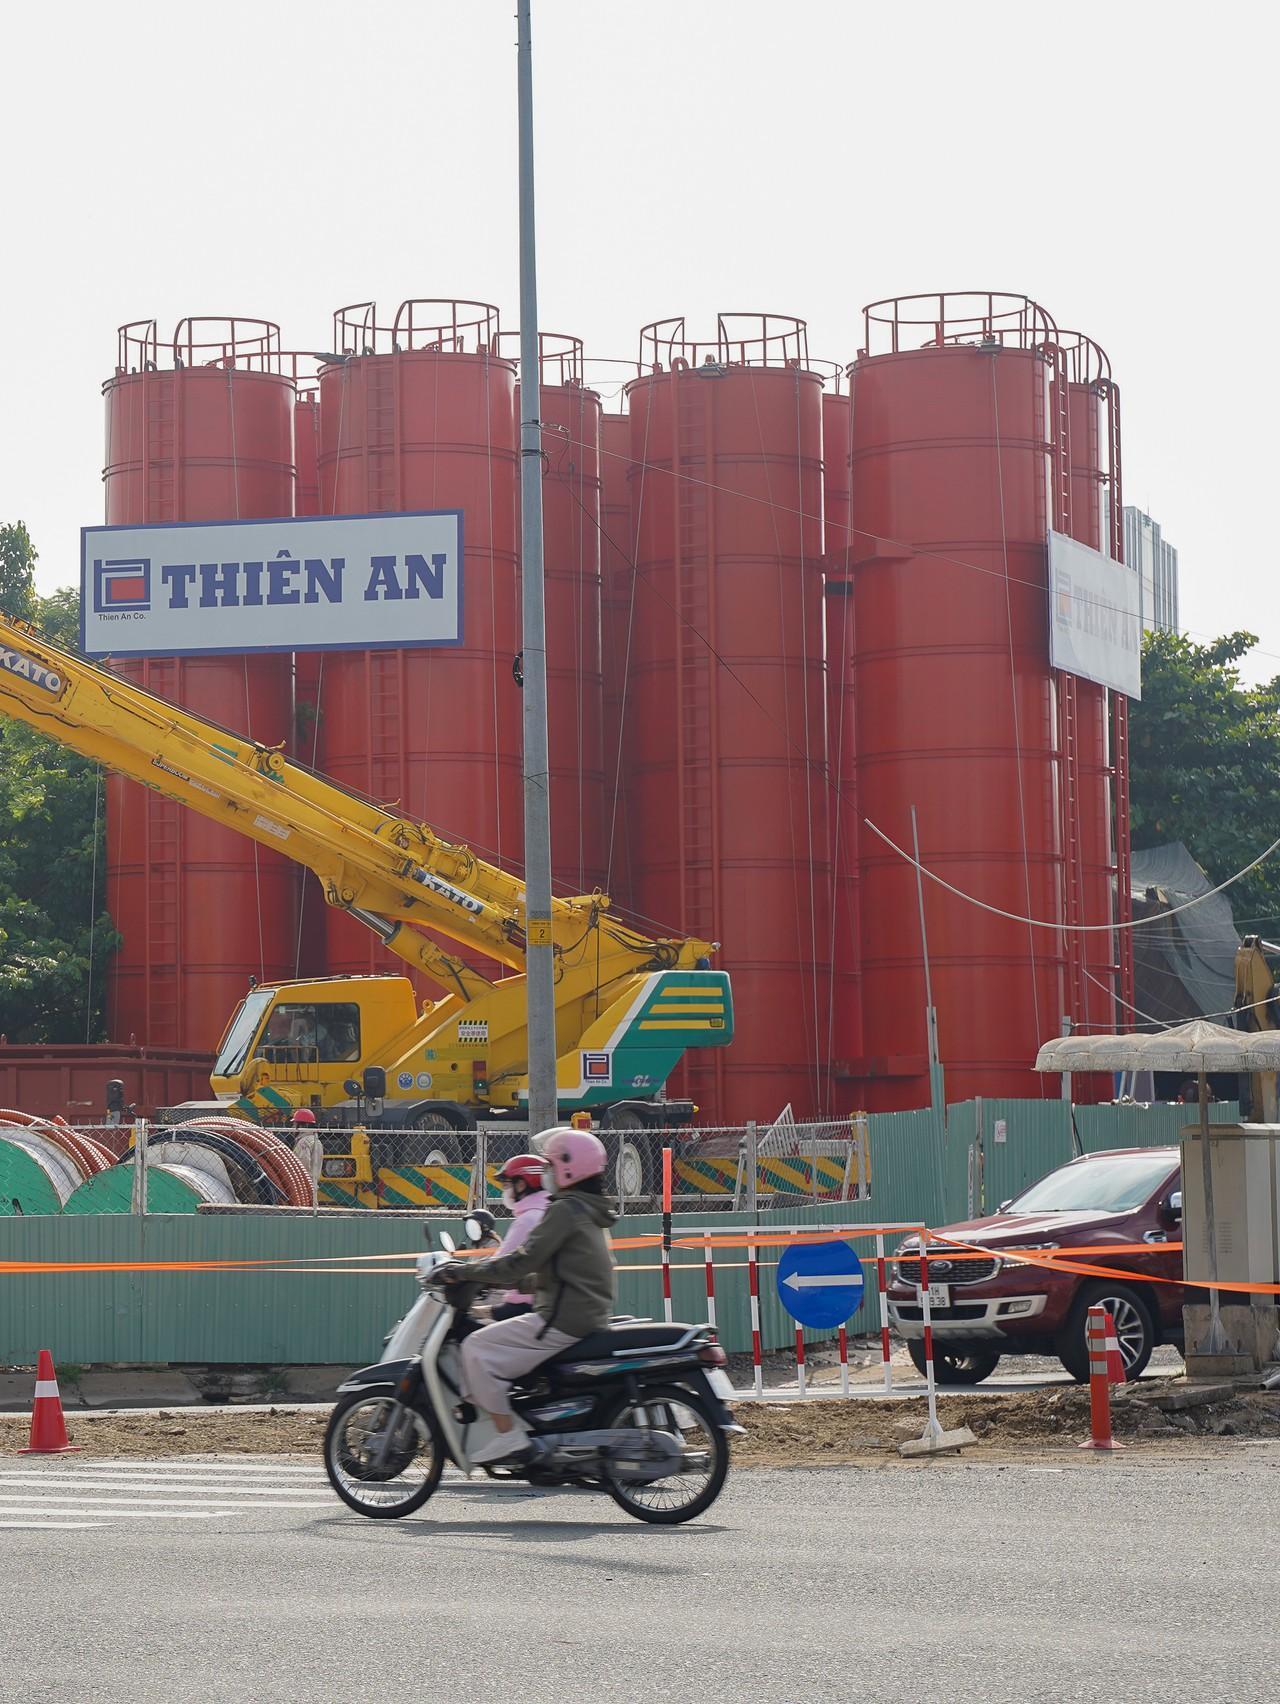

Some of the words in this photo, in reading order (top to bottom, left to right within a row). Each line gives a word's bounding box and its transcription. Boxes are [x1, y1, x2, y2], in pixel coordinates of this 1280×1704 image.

[161, 549, 346, 609] THIÊN
[363, 553, 447, 601] AN
[98, 613, 120, 622] Thien
[120, 613, 132, 621] An
[133, 612, 146, 620] Co.
[422, 873, 478, 912] KATO
[539, 928, 545, 938] 2
